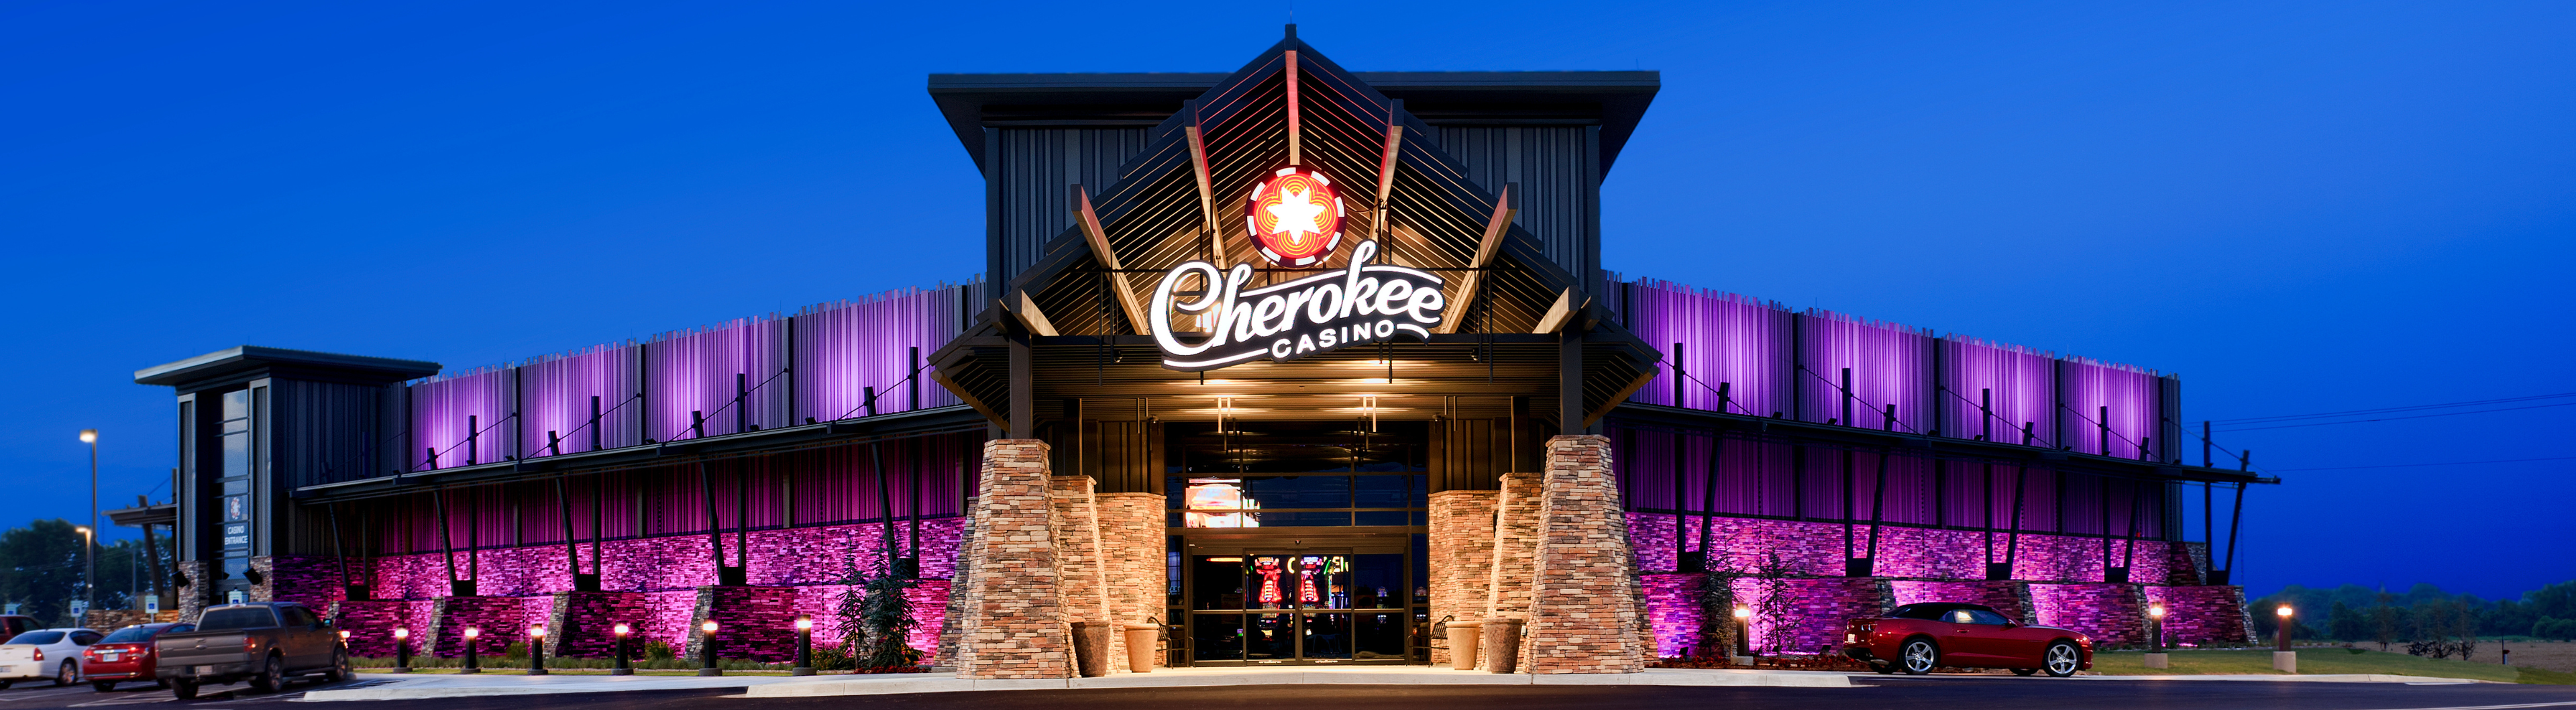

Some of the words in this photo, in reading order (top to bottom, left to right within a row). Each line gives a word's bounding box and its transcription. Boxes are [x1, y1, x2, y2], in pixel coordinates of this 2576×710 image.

[1150, 240, 1444, 356] Cherokee
[1272, 319, 1394, 358] CASINO
[225, 536, 248, 545] ENTRANCE
[227, 525, 244, 535] CASINO
